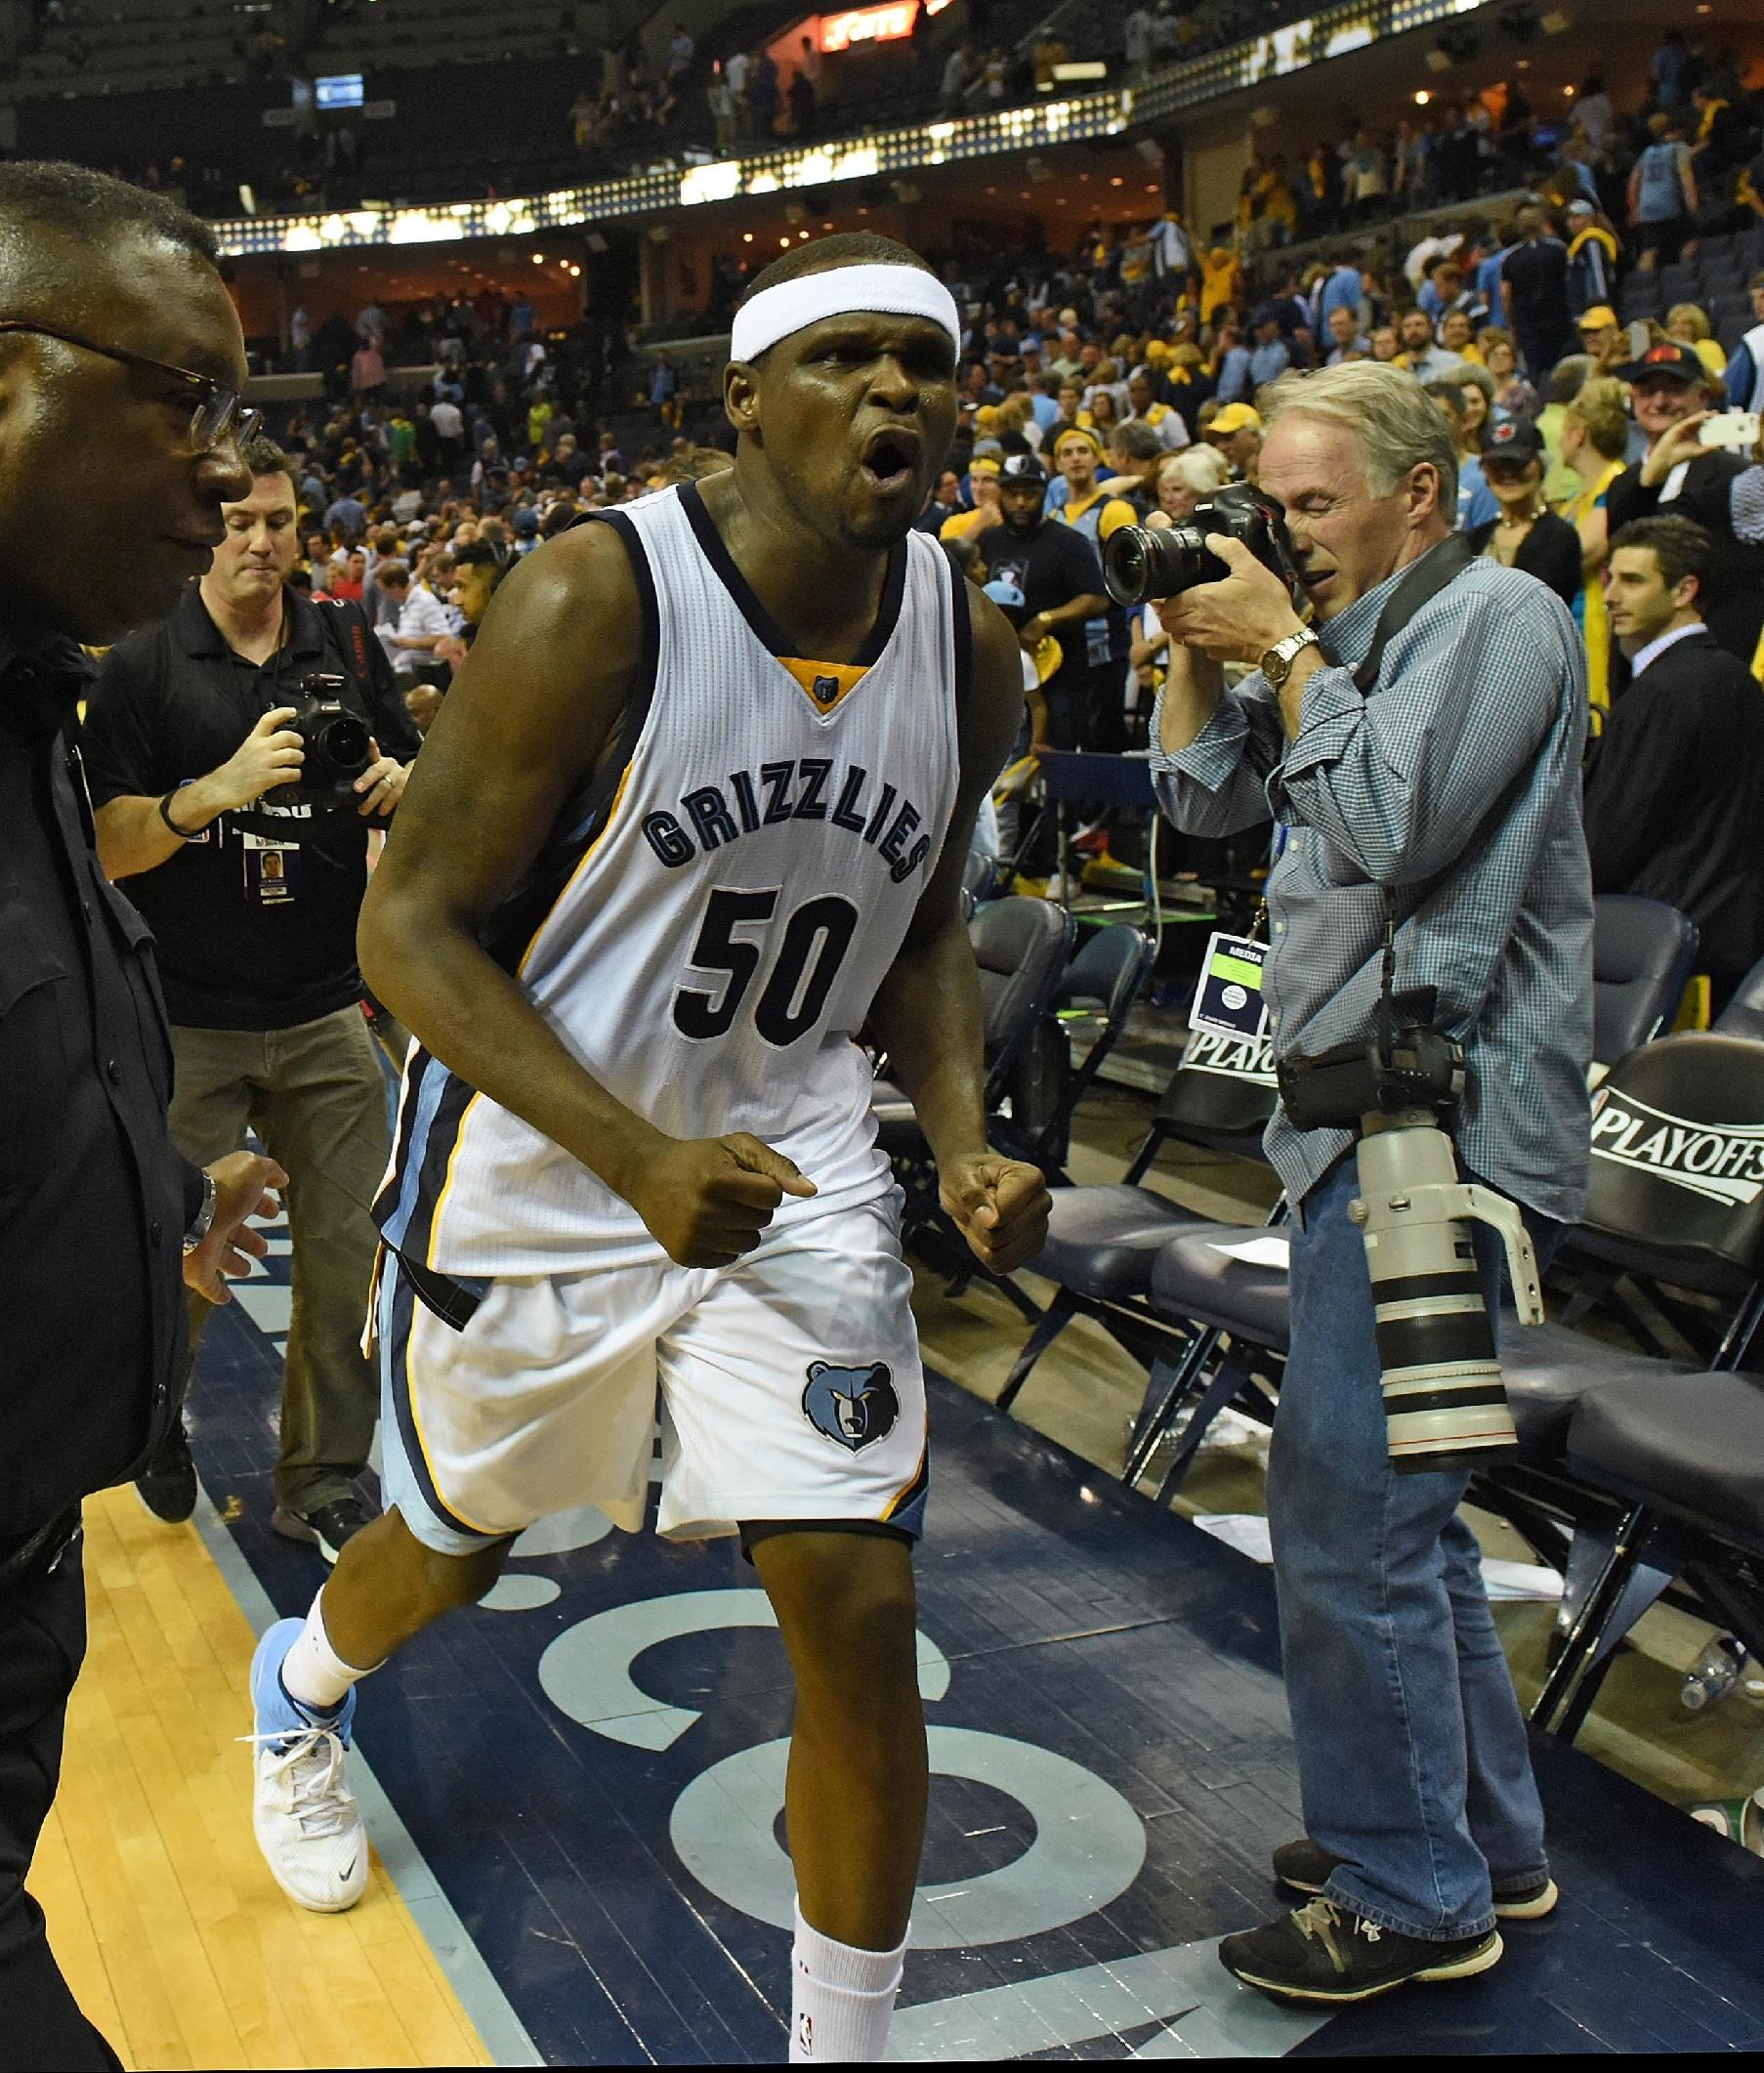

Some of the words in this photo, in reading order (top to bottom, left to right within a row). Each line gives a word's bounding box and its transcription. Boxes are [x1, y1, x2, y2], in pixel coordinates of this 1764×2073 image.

[641, 758, 930, 884] GRIZZLIES
[669, 884, 861, 1050] 50
[1229, 947, 1262, 963] MEDIA
